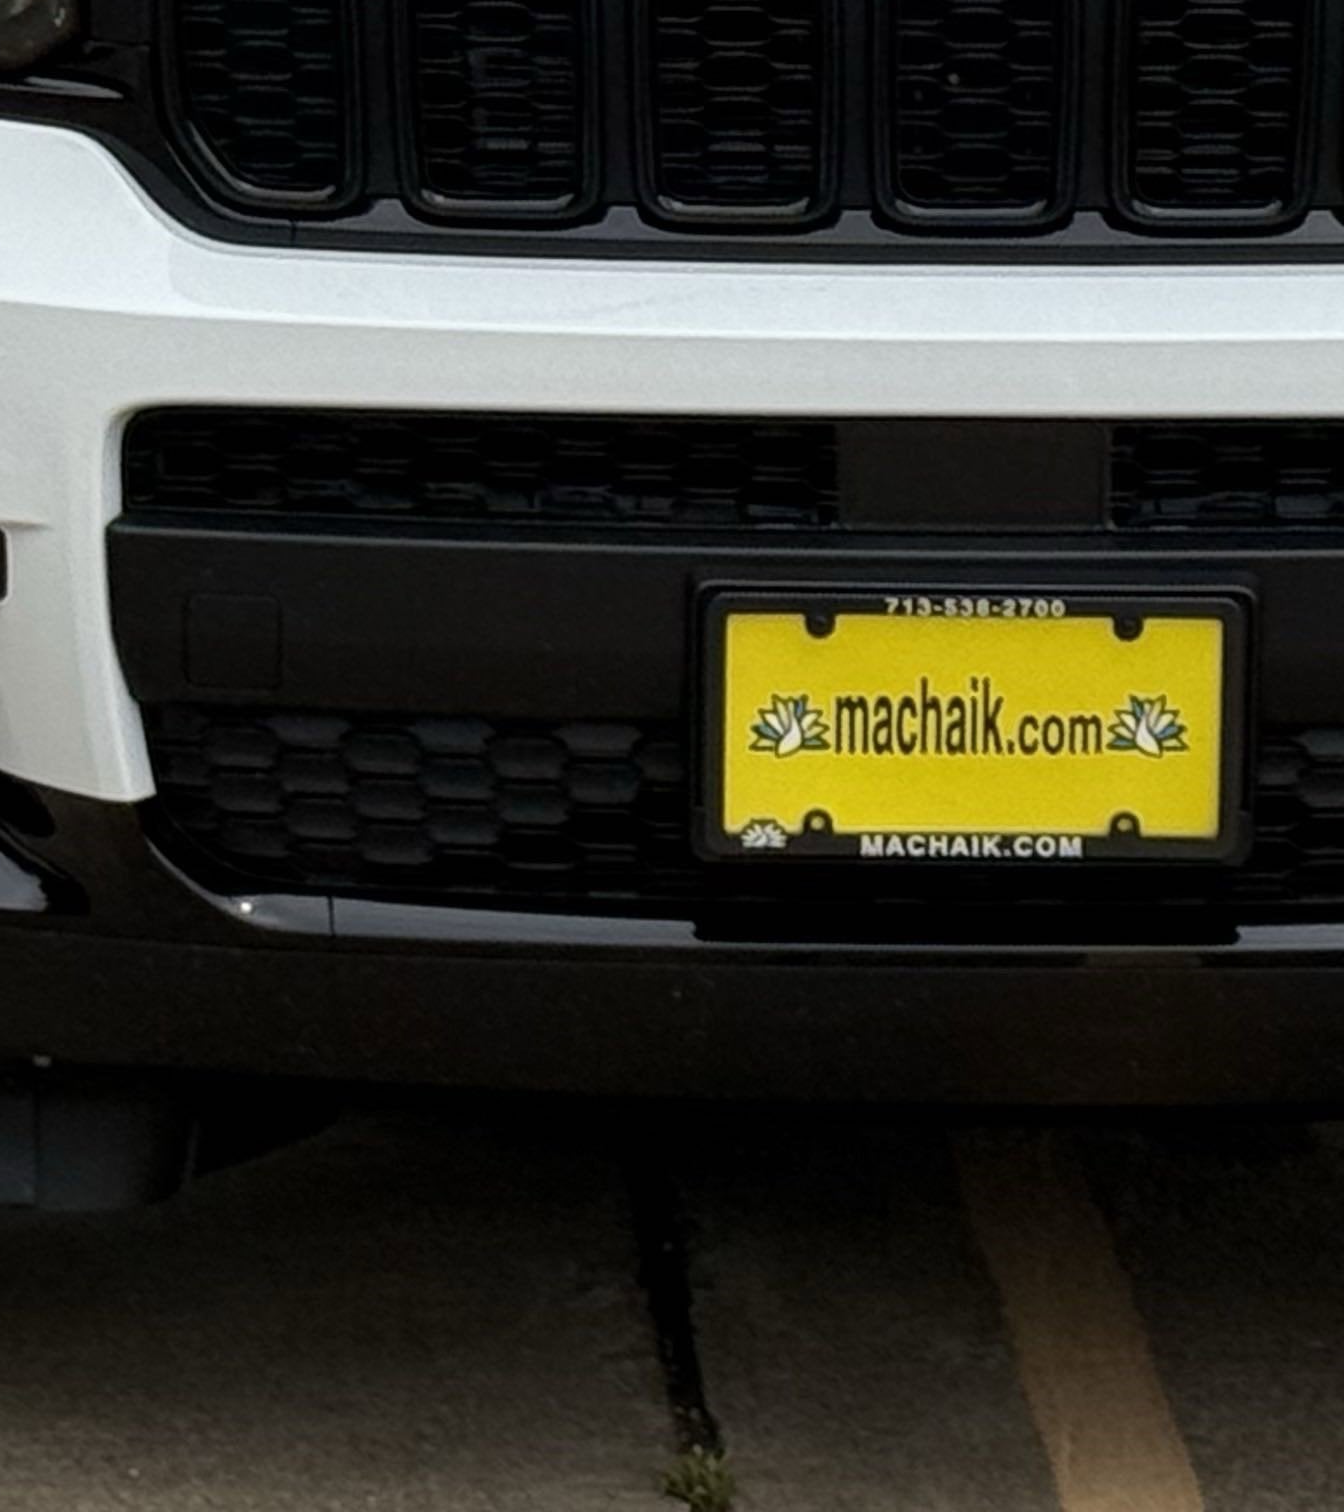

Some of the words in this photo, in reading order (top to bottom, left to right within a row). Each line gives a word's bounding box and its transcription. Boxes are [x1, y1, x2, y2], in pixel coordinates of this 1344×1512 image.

[884, 596, 1067, 618] 713-538-2700
[834, 677, 1105, 756] machaik.com
[859, 833, 1084, 859] MACHAIK.COM
